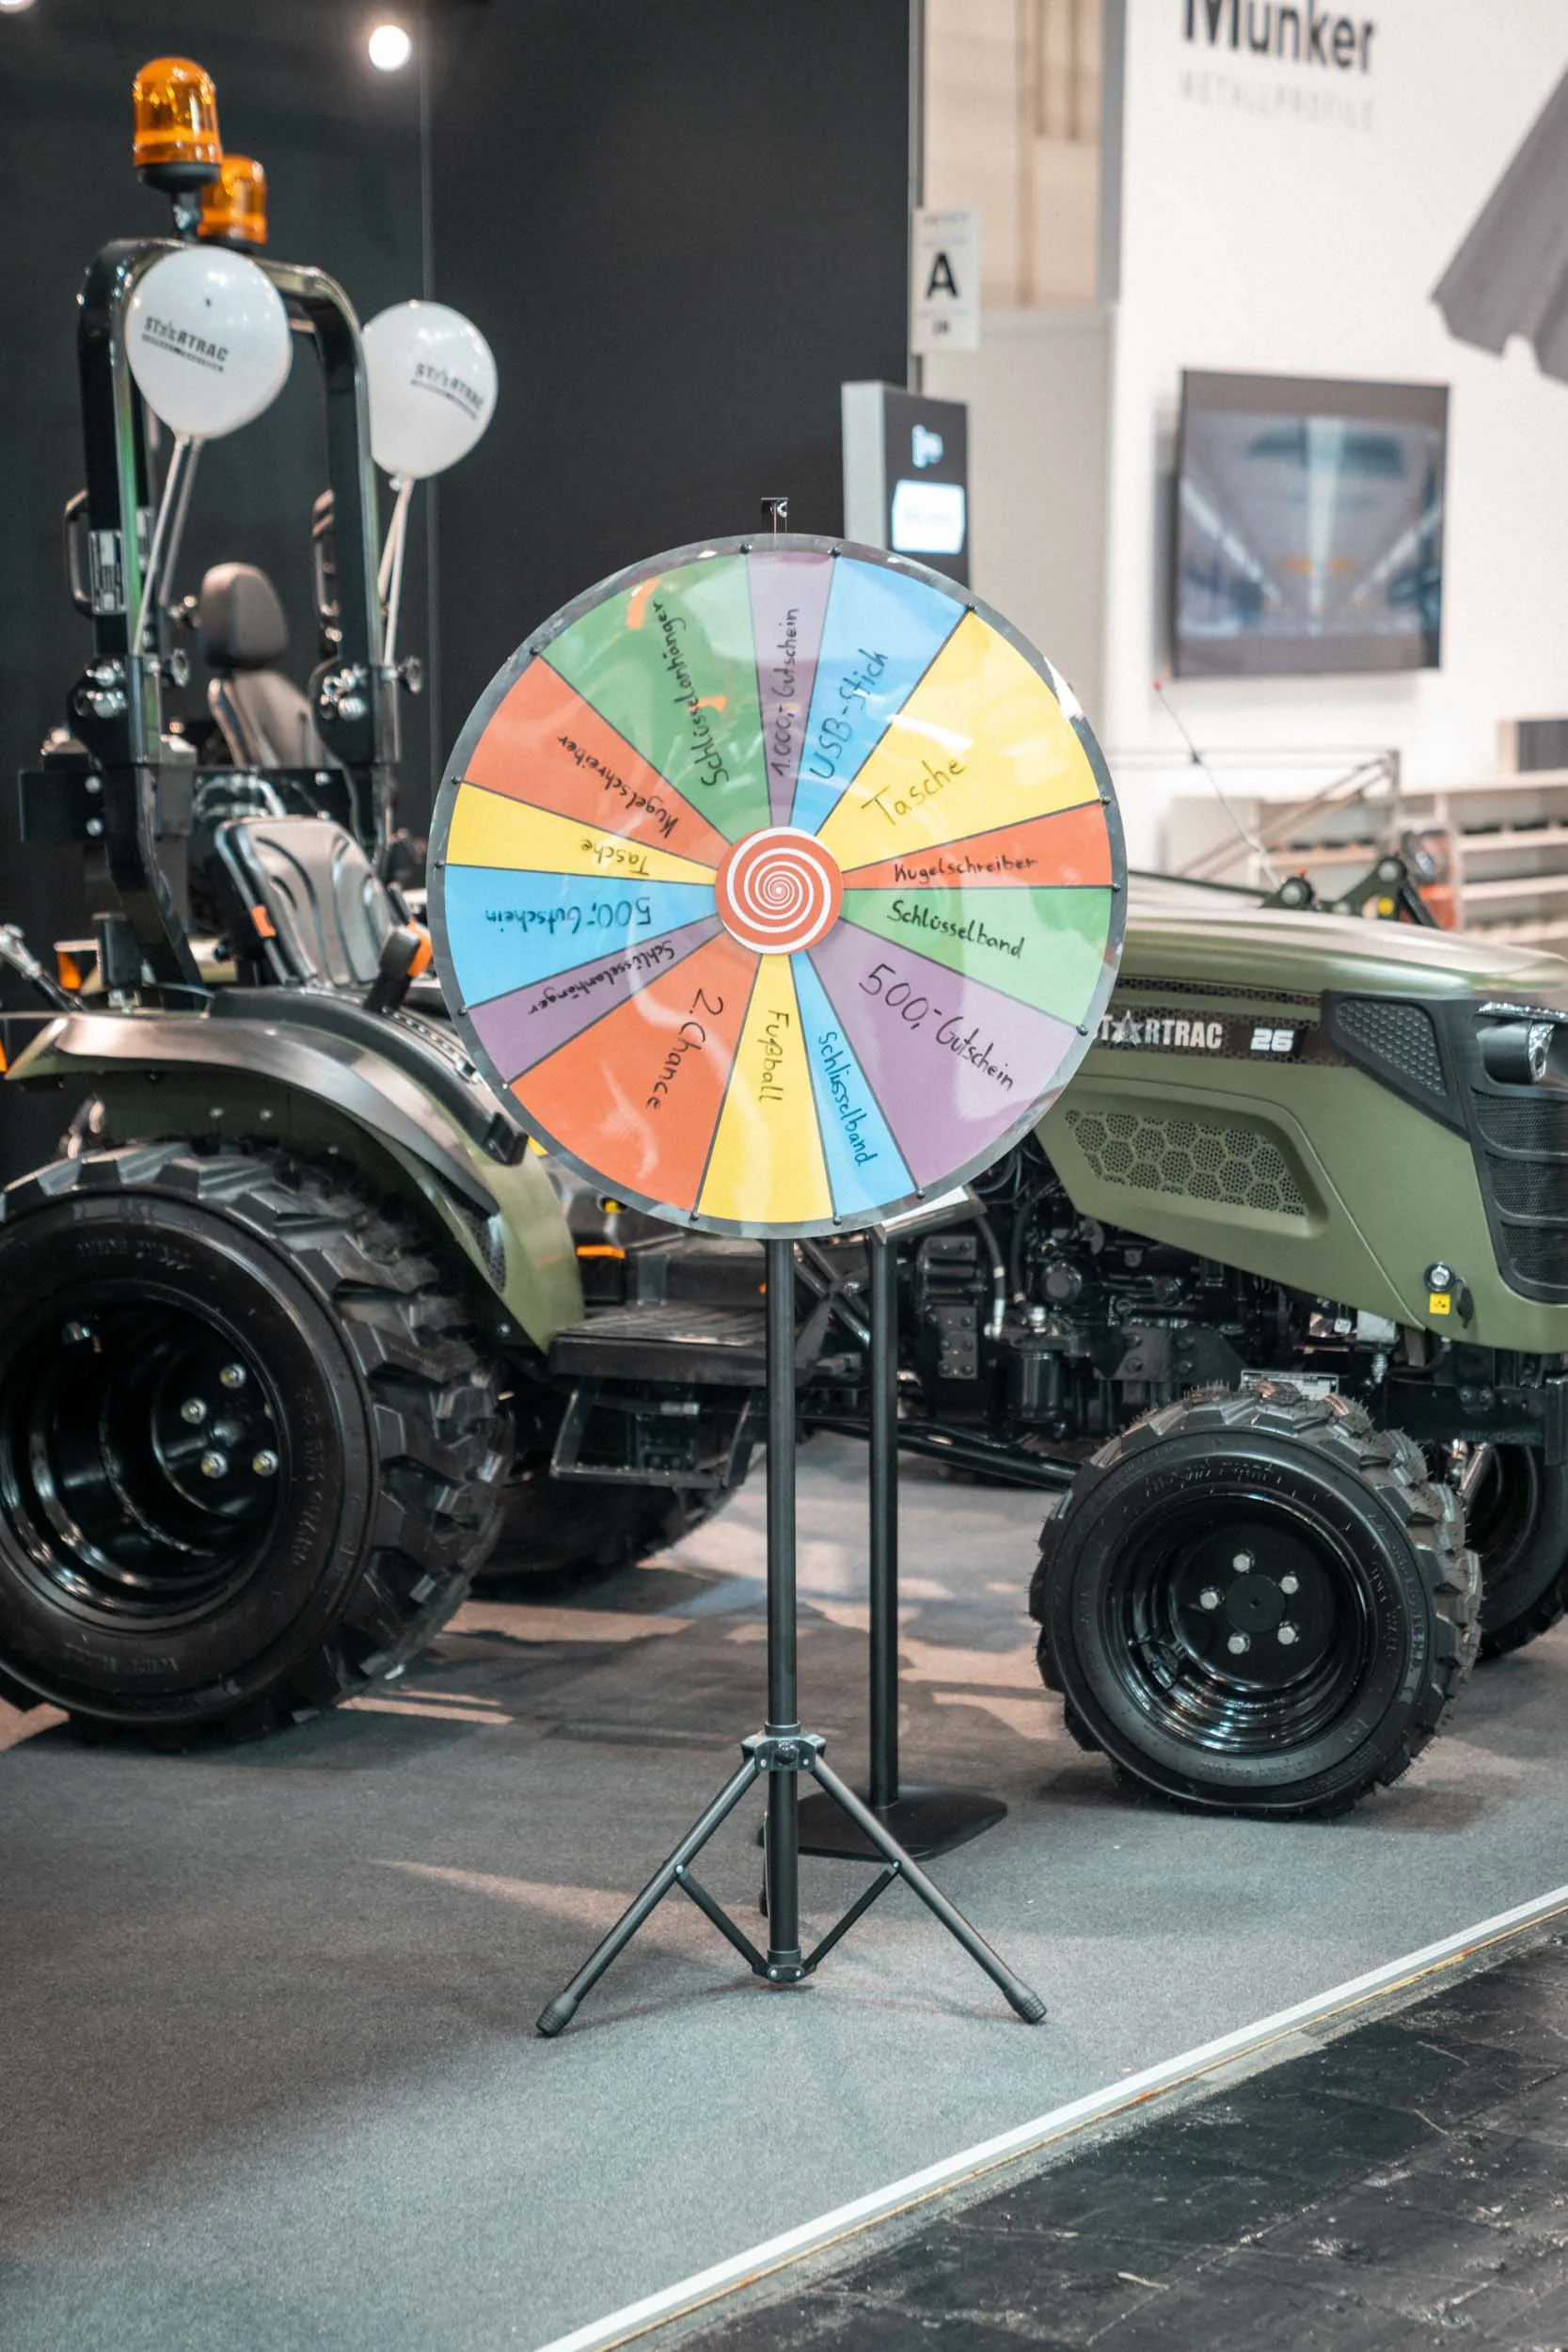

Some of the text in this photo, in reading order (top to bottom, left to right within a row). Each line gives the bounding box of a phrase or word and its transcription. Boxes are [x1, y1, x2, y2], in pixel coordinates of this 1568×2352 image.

[925, 250, 959, 299] A
[809, 647, 889, 780] USB-Stick
[556, 735, 680, 839] Kugelschreiber
[861, 755, 967, 826] Tasche
[579, 838, 650, 876] Tasche
[894, 856, 1038, 884] Kugelschreiber
[886, 899, 1025, 959] Schlüsselband
[645, 1021, 706, 1110] Chance
[757, 1009, 790, 1102] Fußball
[1250, 1026, 1295, 1053] 26
